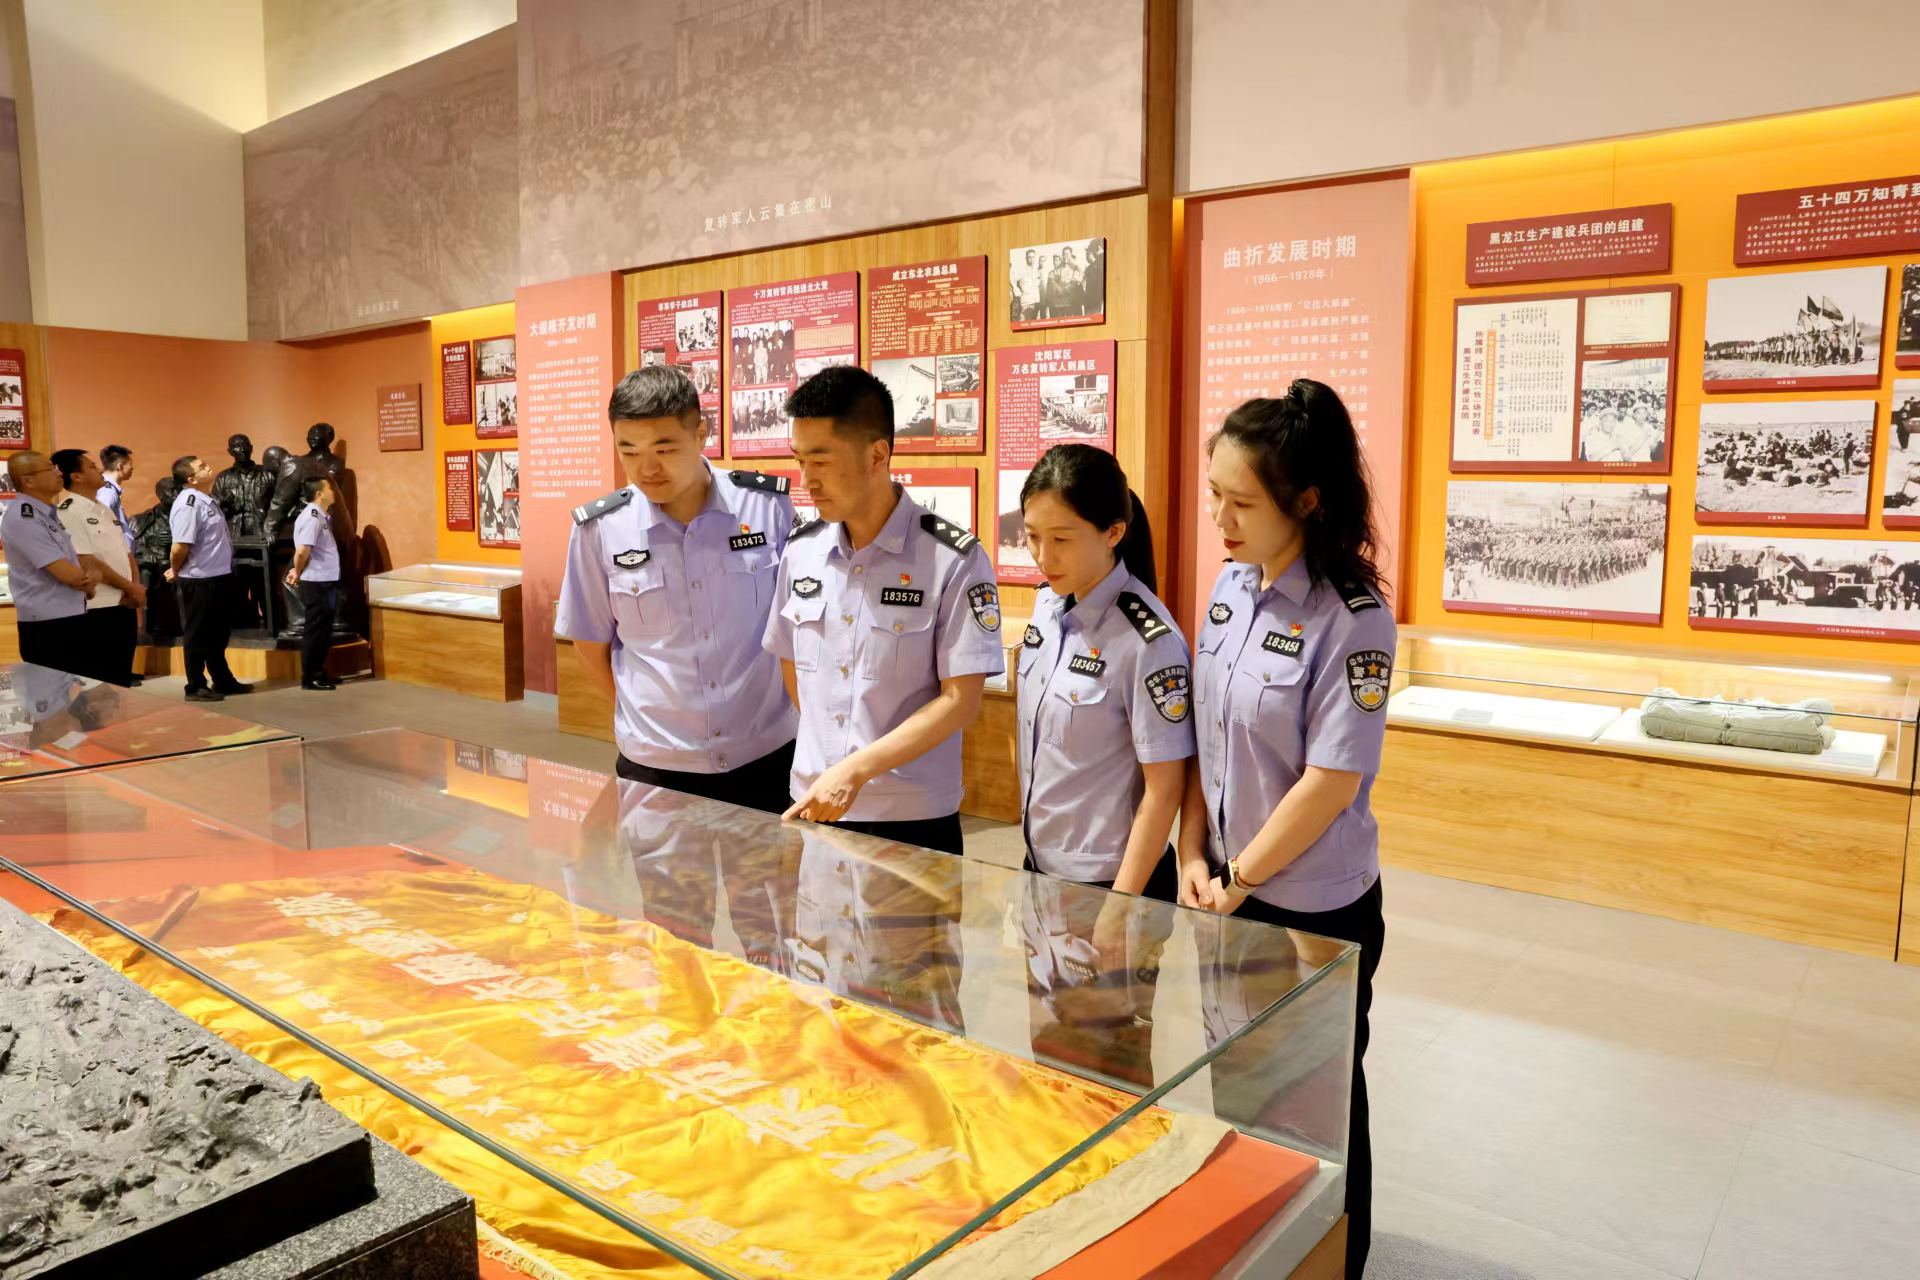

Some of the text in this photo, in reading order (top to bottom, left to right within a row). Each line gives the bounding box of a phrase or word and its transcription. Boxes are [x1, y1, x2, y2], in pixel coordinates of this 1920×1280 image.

[703, 192, 832, 233] 复转军人云集在密山
[1489, 217, 1645, 245] 黑龙江生产建设兵团的组建
[1223, 234, 1357, 269] 曲折发展时期
[1034, 349, 1072, 361] 沈阳军区
[731, 534, 765, 549] 183473
[883, 590, 921, 603] 183576
[1265, 634, 1301, 653] 183458
[1070, 656, 1102, 673] 183457
